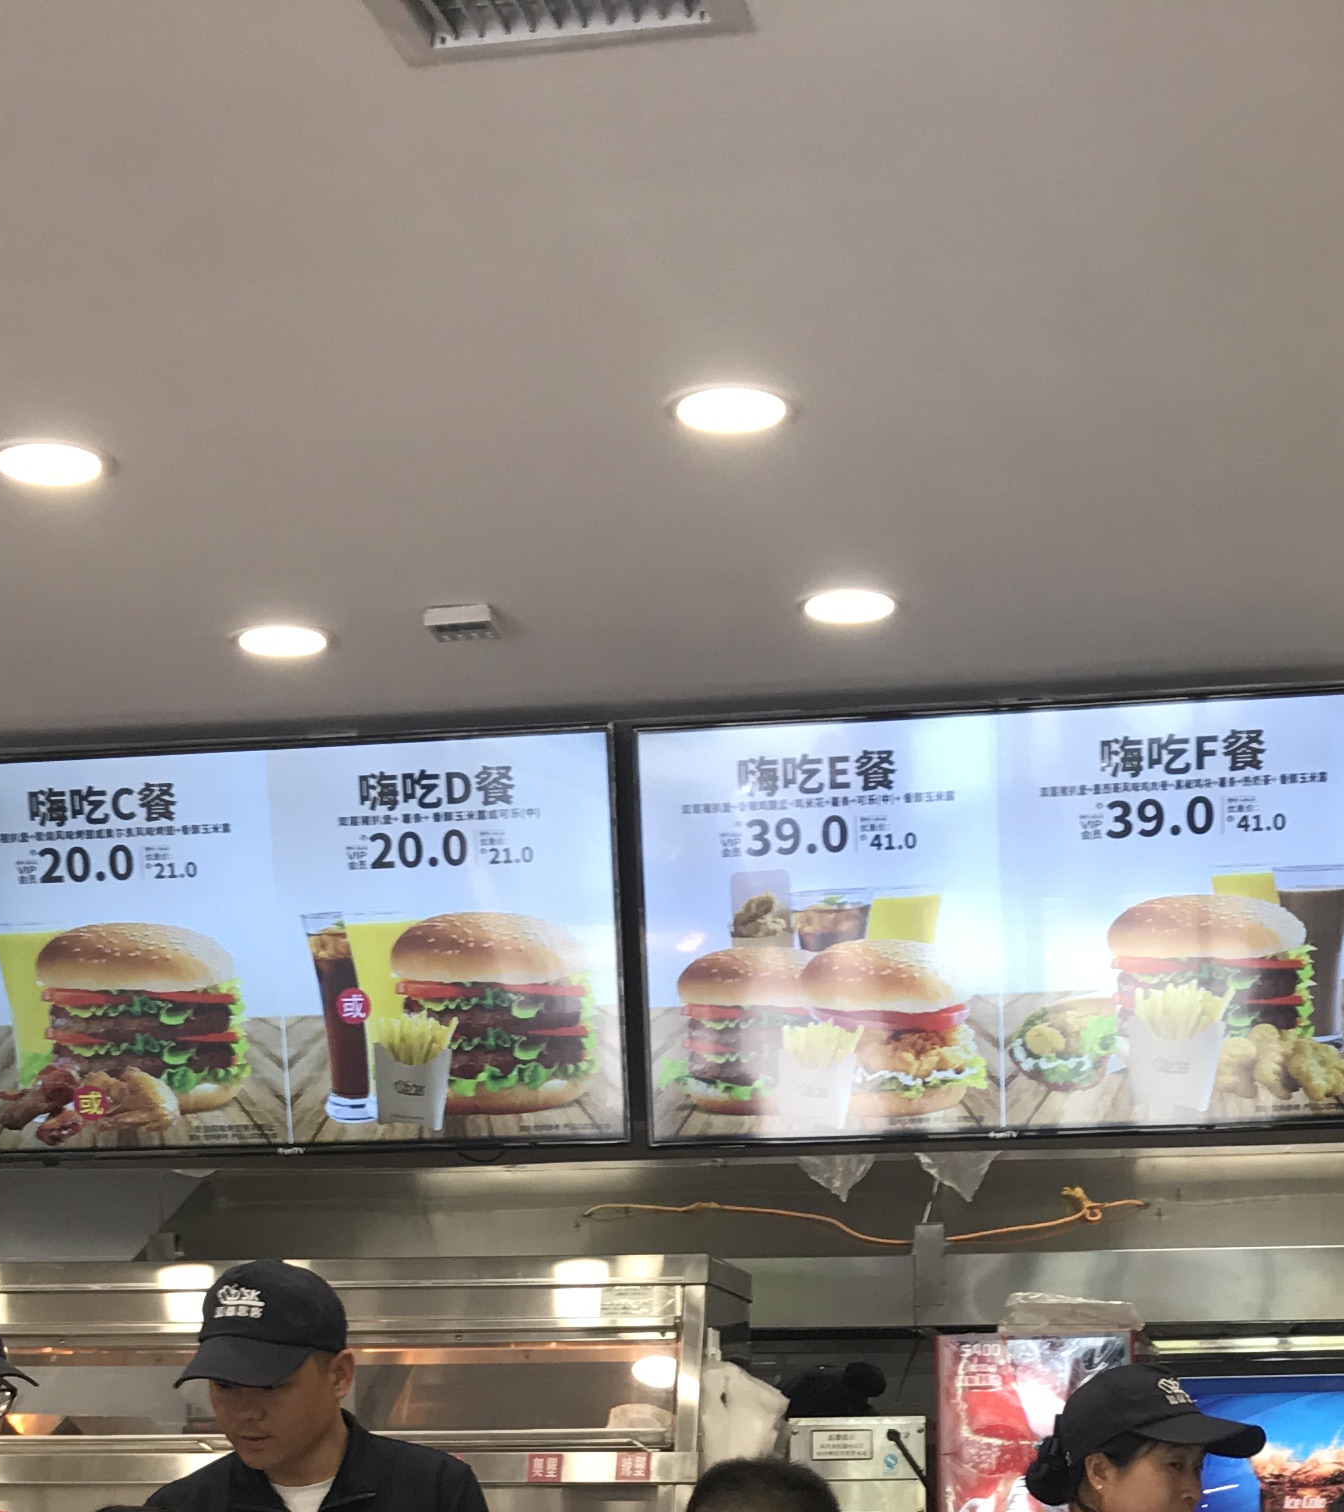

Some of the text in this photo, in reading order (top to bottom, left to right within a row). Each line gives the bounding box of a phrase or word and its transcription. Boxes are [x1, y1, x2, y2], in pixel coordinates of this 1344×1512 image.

[1100, 728, 1267, 778] 嗨吃F餐
[358, 765, 516, 811] 嗨吃D餐
[737, 750, 898, 797] 嗨吃E餐
[27, 782, 178, 827] 嗨吃C餐
[1106, 795, 1214, 839] 39.0
[1236, 813, 1287, 832] 41.0
[369, 829, 467, 870] 20.0
[488, 846, 534, 865] 21.0
[745, 815, 848, 857] 39.0
[869, 832, 917, 850] 41.0
[38, 844, 135, 884] 20.0
[153, 861, 198, 879] 21.0
[341, 994, 367, 1021] 或
[78, 1090, 104, 1118] 或
